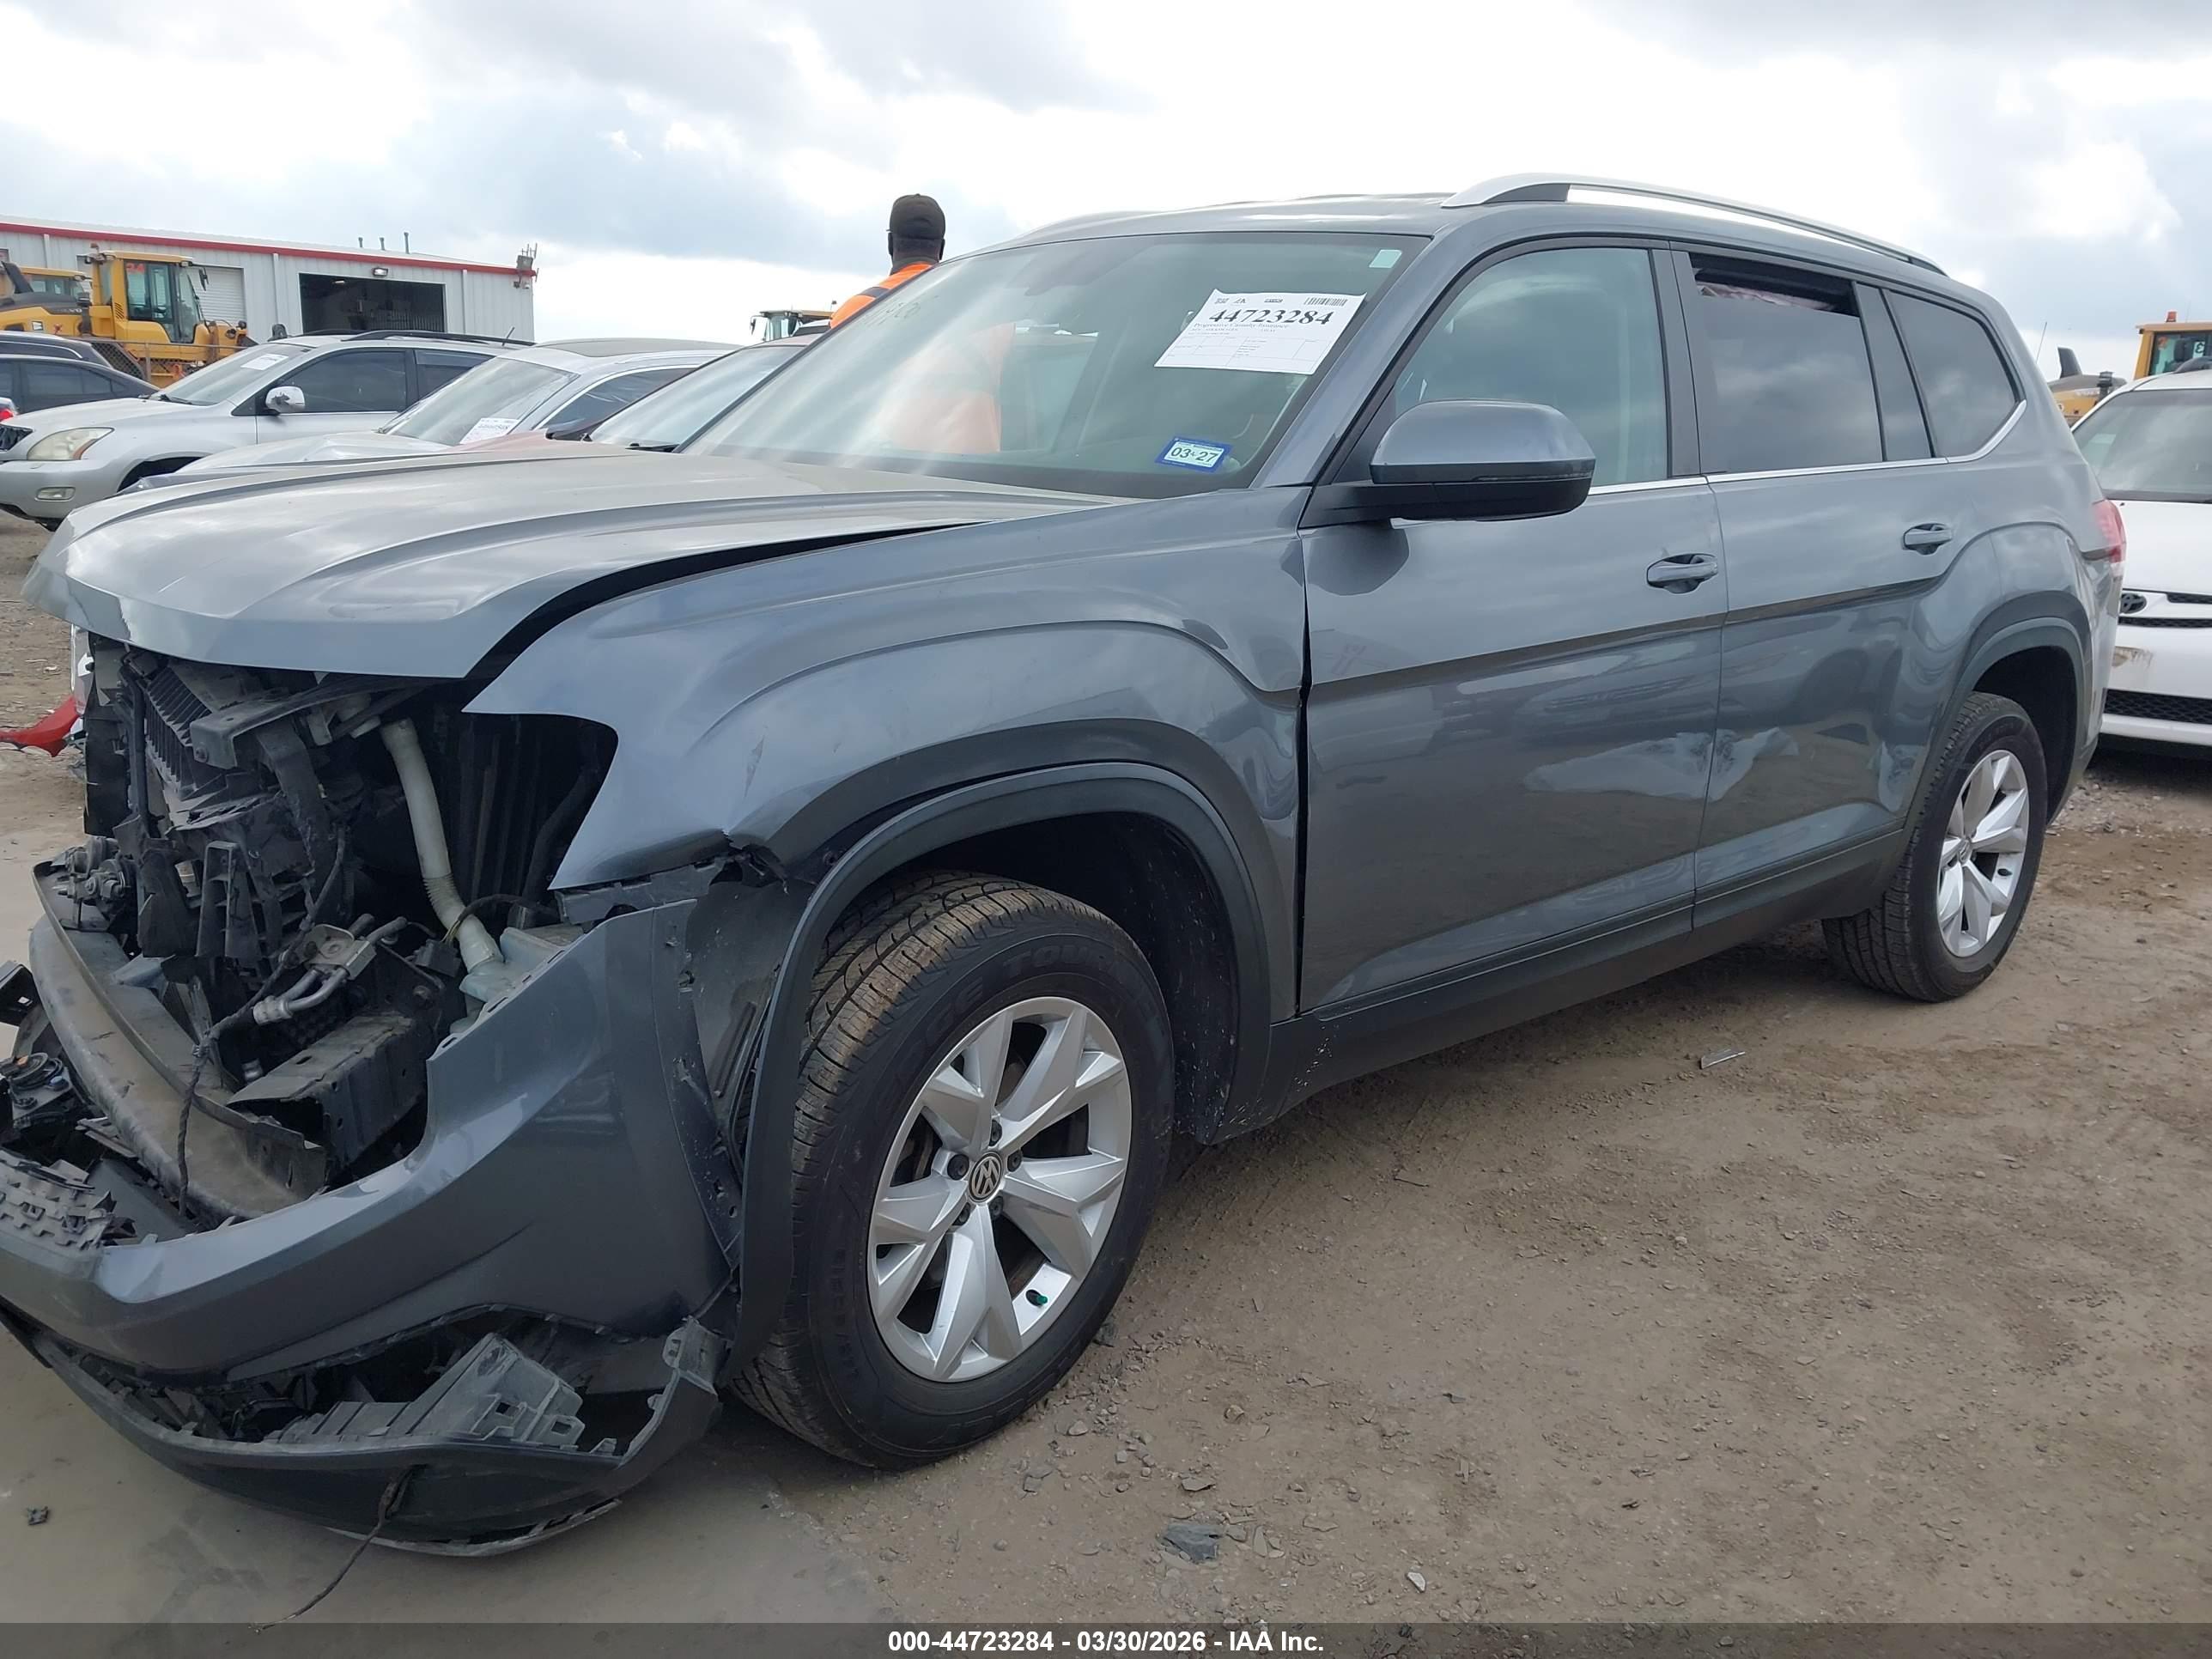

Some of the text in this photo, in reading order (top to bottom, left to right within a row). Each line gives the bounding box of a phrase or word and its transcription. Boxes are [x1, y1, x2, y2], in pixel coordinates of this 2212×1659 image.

[1209, 309, 1334, 325] 44723284
[1170, 447, 1192, 459] 03
[1195, 451, 1218, 463] 27
